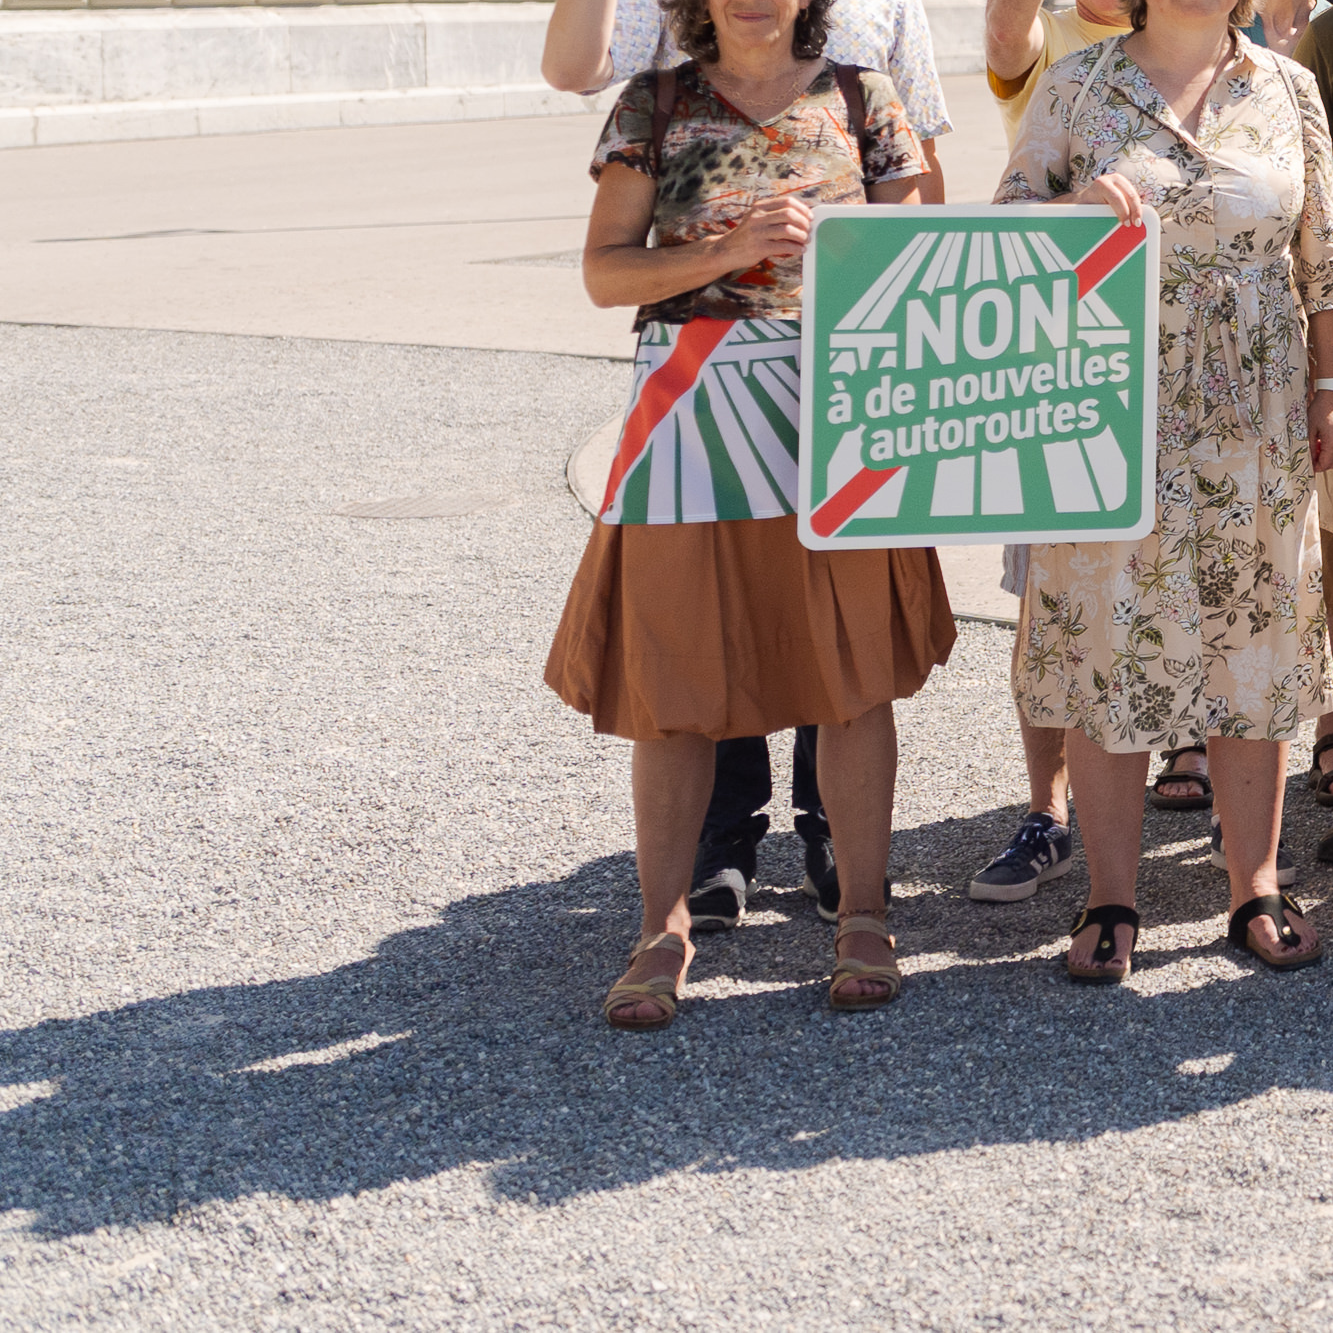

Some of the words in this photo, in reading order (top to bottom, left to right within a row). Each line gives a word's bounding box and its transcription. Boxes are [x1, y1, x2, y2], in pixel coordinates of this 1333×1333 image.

[905, 278, 1070, 370] NON
[827, 380, 852, 424] à
[865, 375, 915, 418] de
[929, 348, 1130, 409] nouvelles
[869, 398, 1100, 461] autoroutes
